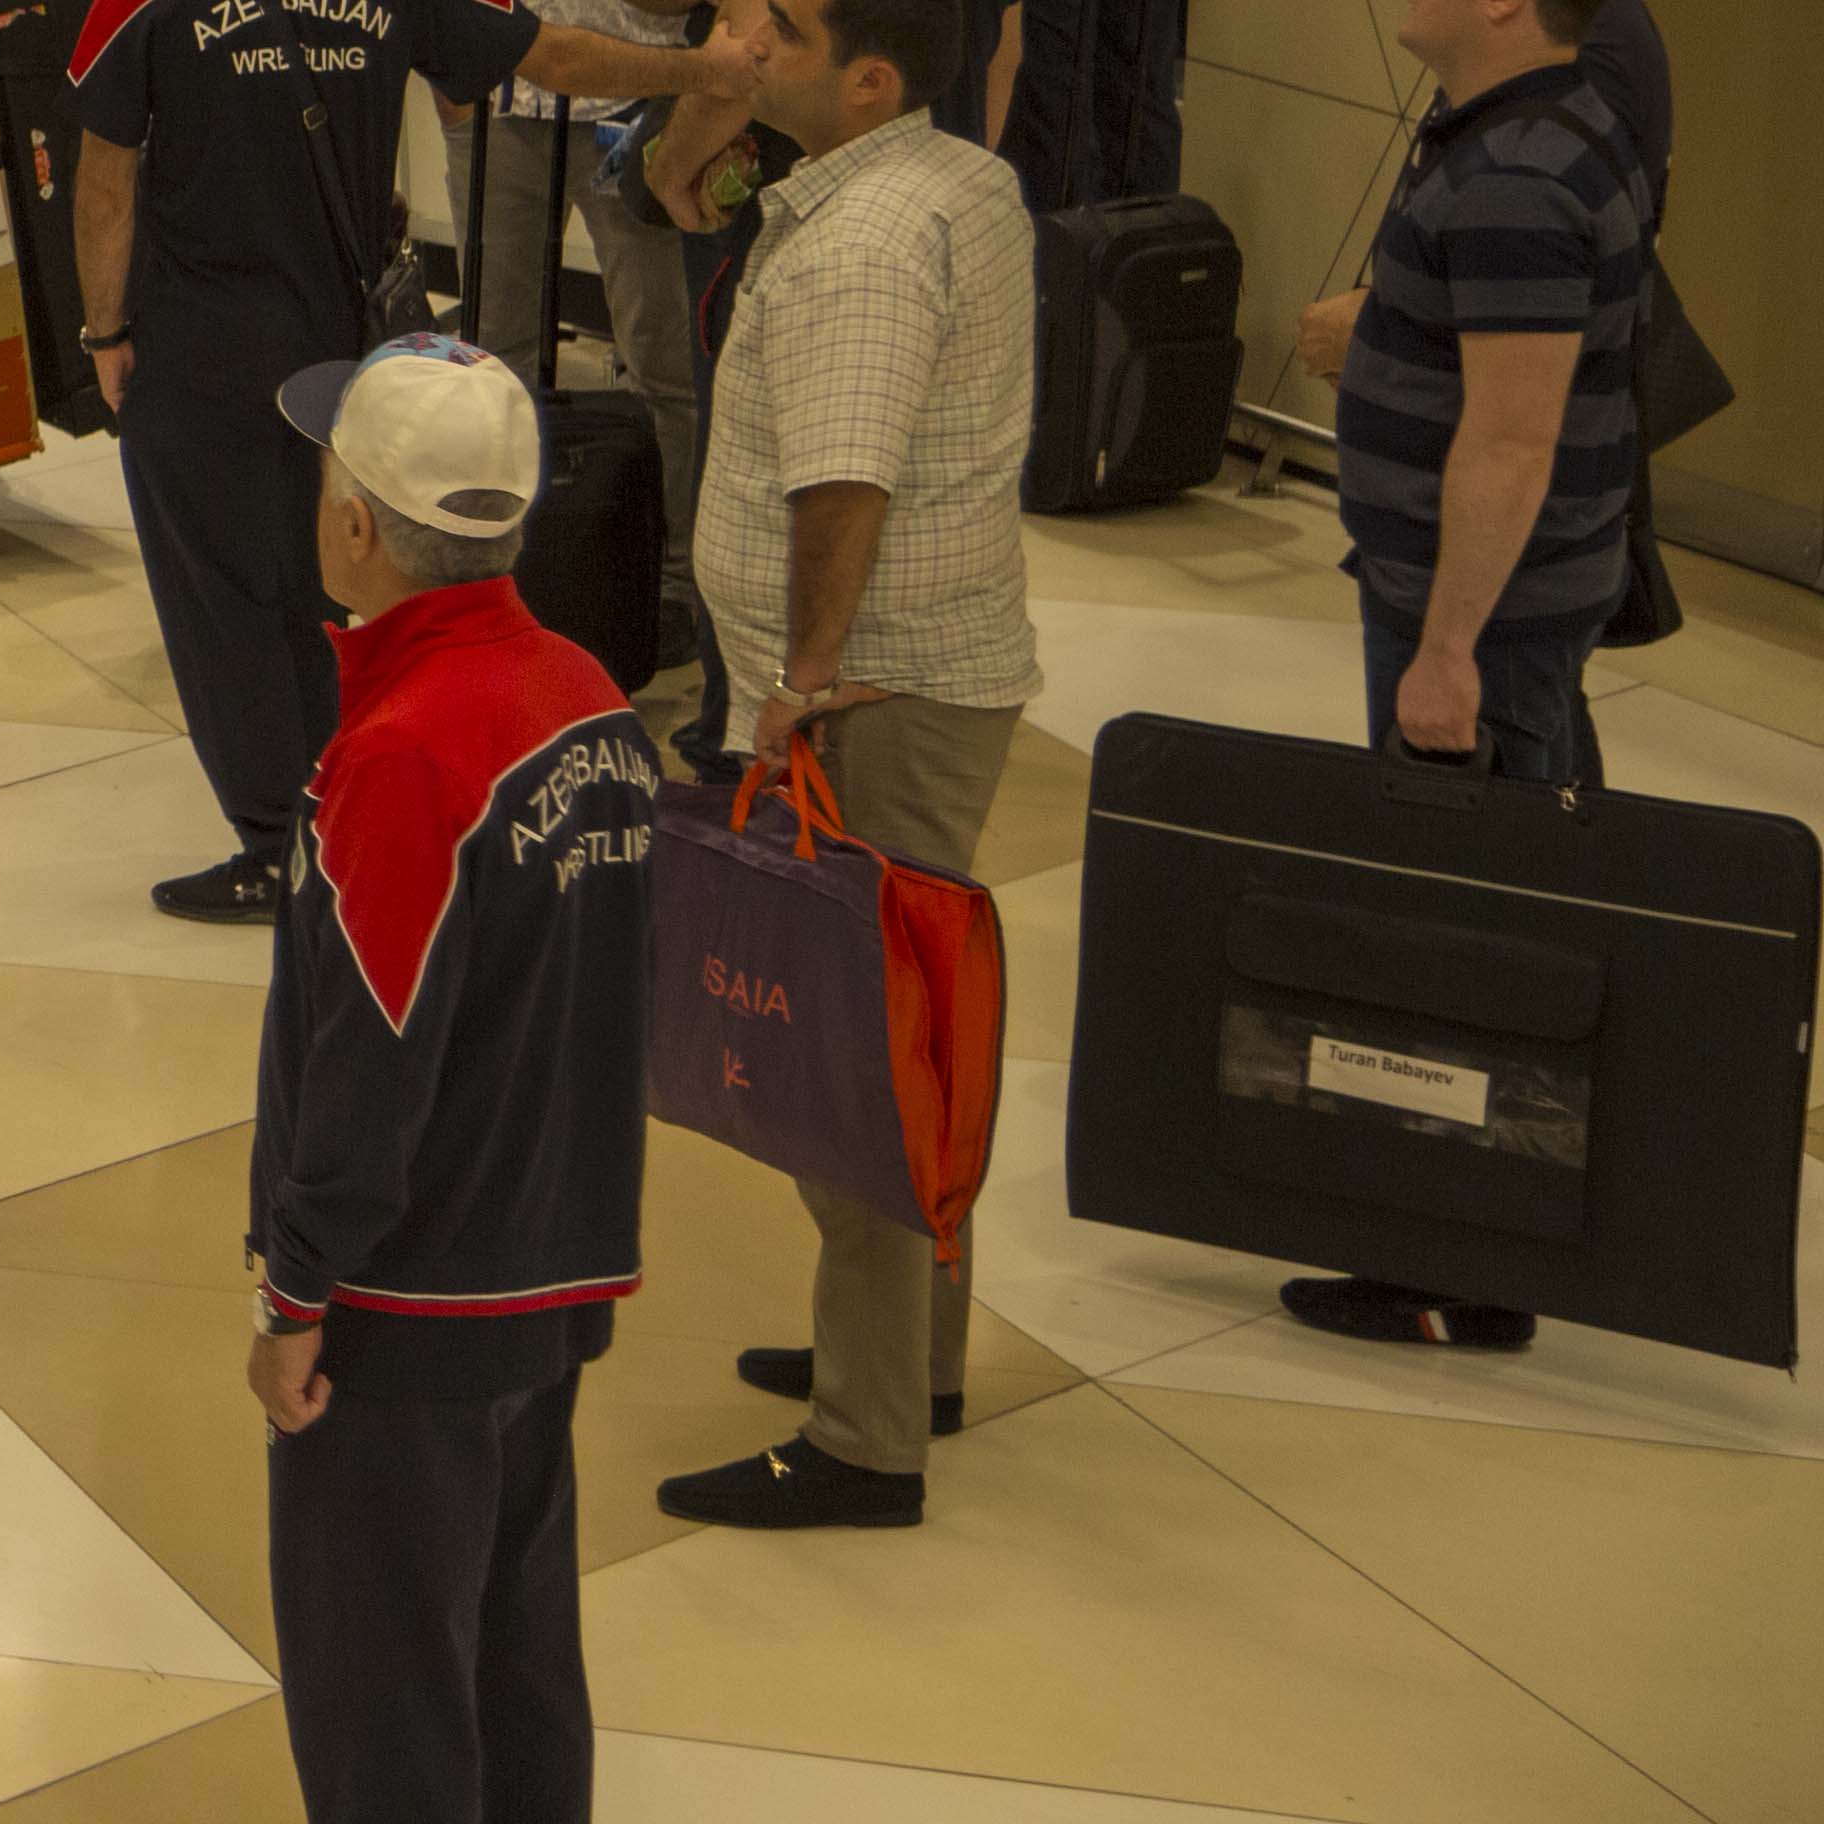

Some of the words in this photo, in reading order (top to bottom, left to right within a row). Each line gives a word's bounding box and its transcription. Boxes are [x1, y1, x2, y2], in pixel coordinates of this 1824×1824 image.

[231, 43, 366, 76] WRETLING
[703, 953, 793, 1025] ISAIA
[1328, 1044, 1377, 1069] Turan
[1381, 1055, 1455, 1085] Babayev
